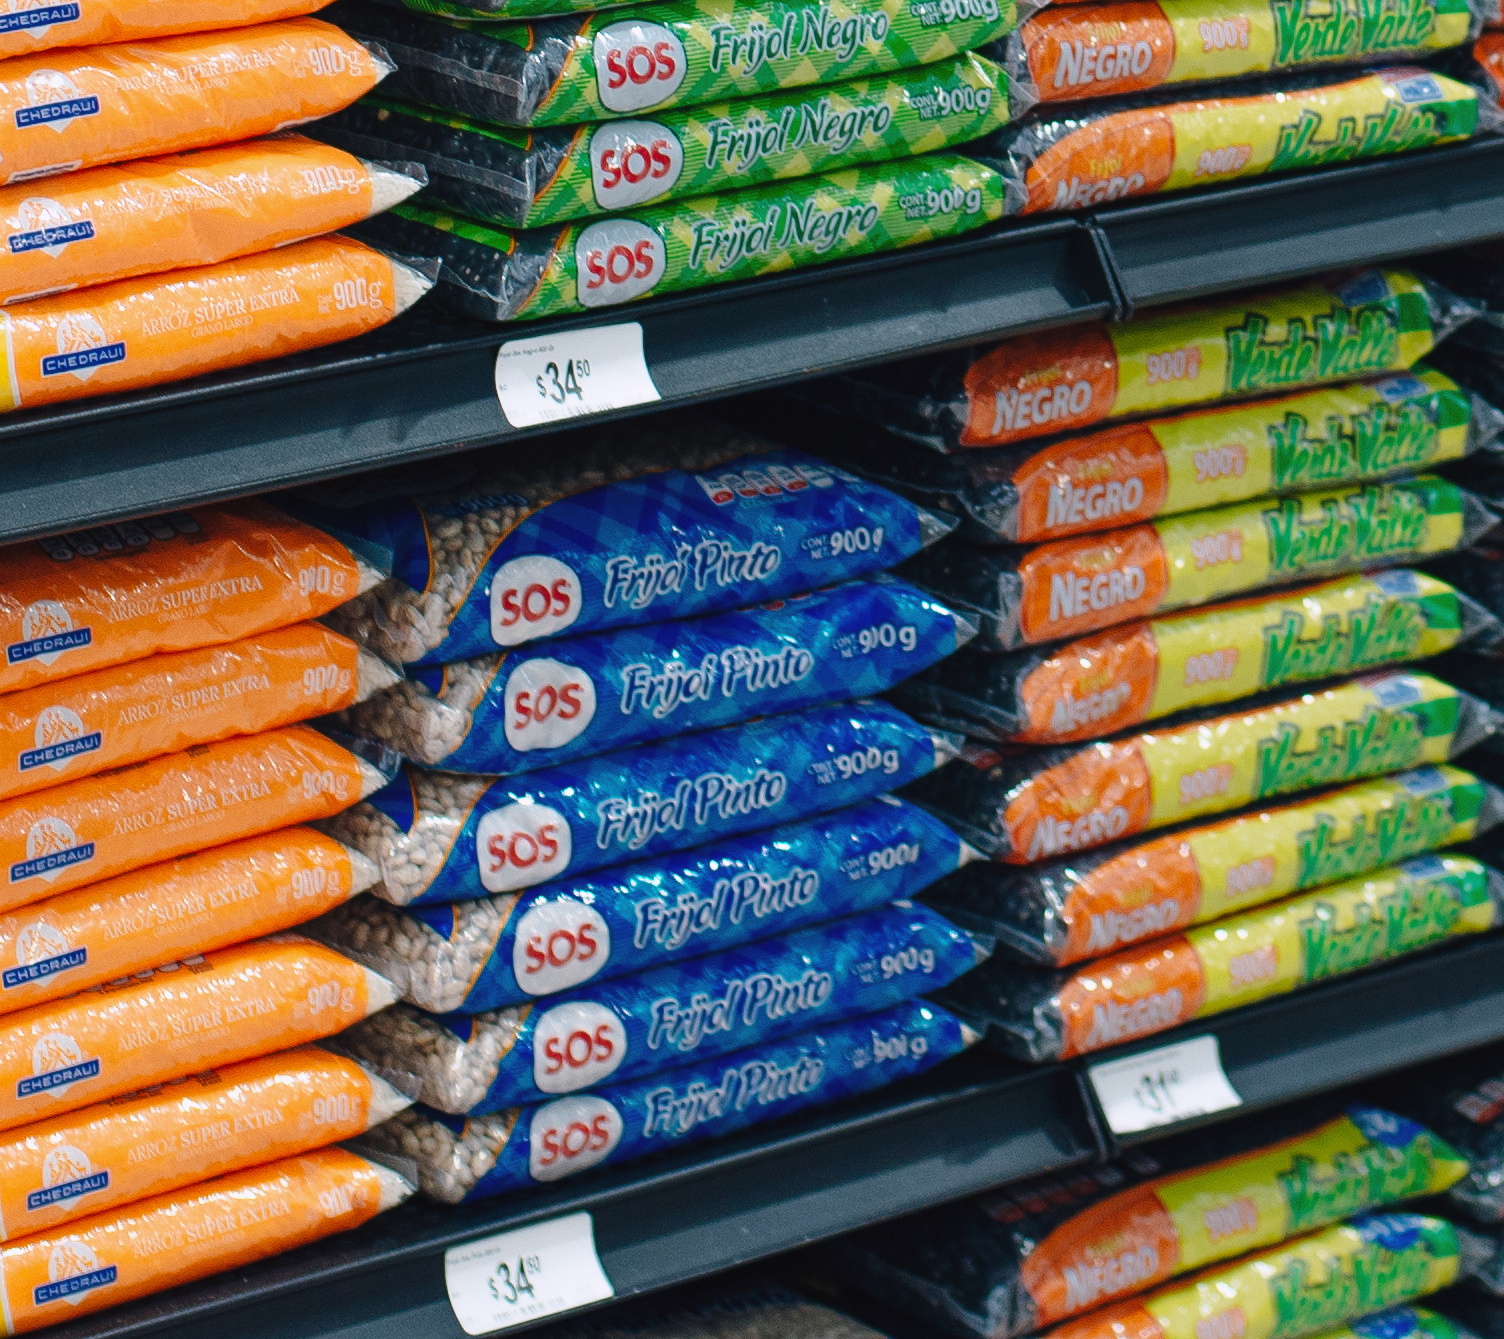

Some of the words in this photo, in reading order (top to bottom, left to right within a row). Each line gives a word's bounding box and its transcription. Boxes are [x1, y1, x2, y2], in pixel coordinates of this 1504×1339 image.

[604, 41, 676, 88] SOS
[709, 11, 792, 74] Frijol
[794, 8, 888, 55] Negro
[1054, 44, 1152, 87] NEGRO
[939, 87, 992, 121] 900g
[705, 106, 794, 171] Frijol
[797, 105, 891, 150] Negro
[600, 140, 671, 187] SOS
[926, 187, 982, 219] 900g
[690, 205, 780, 270] Frijol
[781, 204, 878, 250] Negro
[584, 240, 656, 289] SOS
[194, 299, 245, 325] SUPER
[247, 288, 301, 311] EXTRA
[44, 346, 122, 371] CHEDRAUI
[991, 381, 1091, 435] NEGRO
[604, 552, 691, 609] Frijol
[694, 541, 782, 590] Pinto
[501, 582, 572, 626] SOS
[621, 656, 719, 716] Frijol
[722, 646, 814, 693] Pinto
[513, 685, 583, 728] SOS
[596, 783, 693, 848] Frijol
[696, 770, 787, 822] Pinto
[487, 825, 558, 868] SOS
[634, 879, 732, 949] Frijol
[732, 870, 818, 922] Pinto
[524, 926, 598, 973] SOS
[648, 979, 740, 1050] Frijol
[742, 971, 832, 1025] Pinto
[543, 1027, 614, 1073] SOS
[645, 1068, 738, 1135] Frijol
[738, 1058, 823, 1111] Pinto
[540, 1118, 611, 1165] SOS
